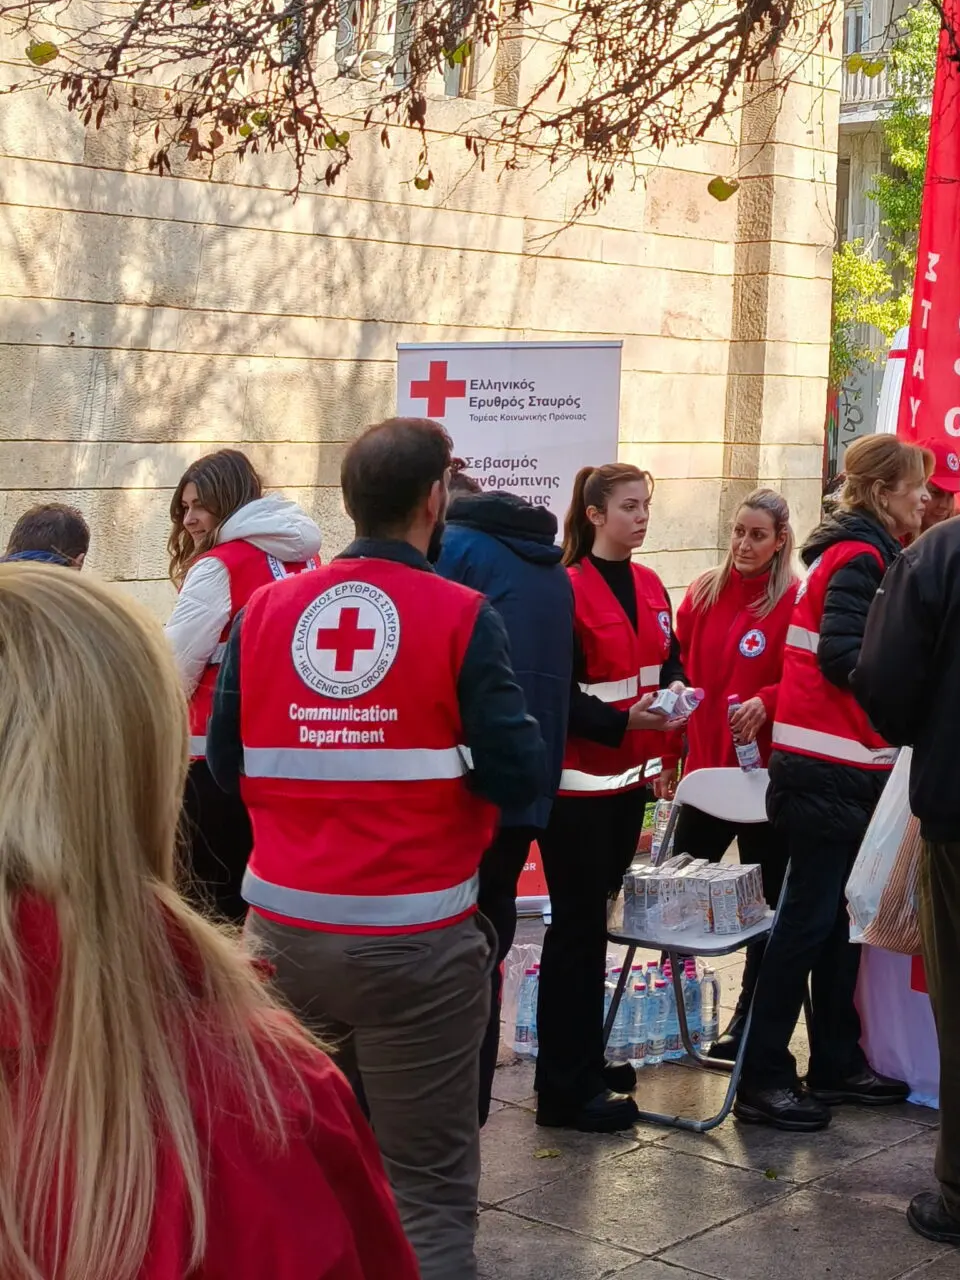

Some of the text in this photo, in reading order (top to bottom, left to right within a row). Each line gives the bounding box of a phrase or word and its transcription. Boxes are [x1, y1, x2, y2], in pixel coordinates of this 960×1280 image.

[470, 378, 535, 392] Ελληνικός
[469, 395, 581, 409] Ερυθρός Σταυρός
[465, 456, 538, 471] Σεβασμός
[295, 583, 396, 652] ΕΛΛΗΝΙΚΟΣ ΕΡΥΘΡΟΣ ΣΤΑΥΡΟΣ
[299, 658, 388, 695] HELLENIC RED CROSS
[289, 703, 398, 722] Communication
[299, 725, 385, 747] Department
